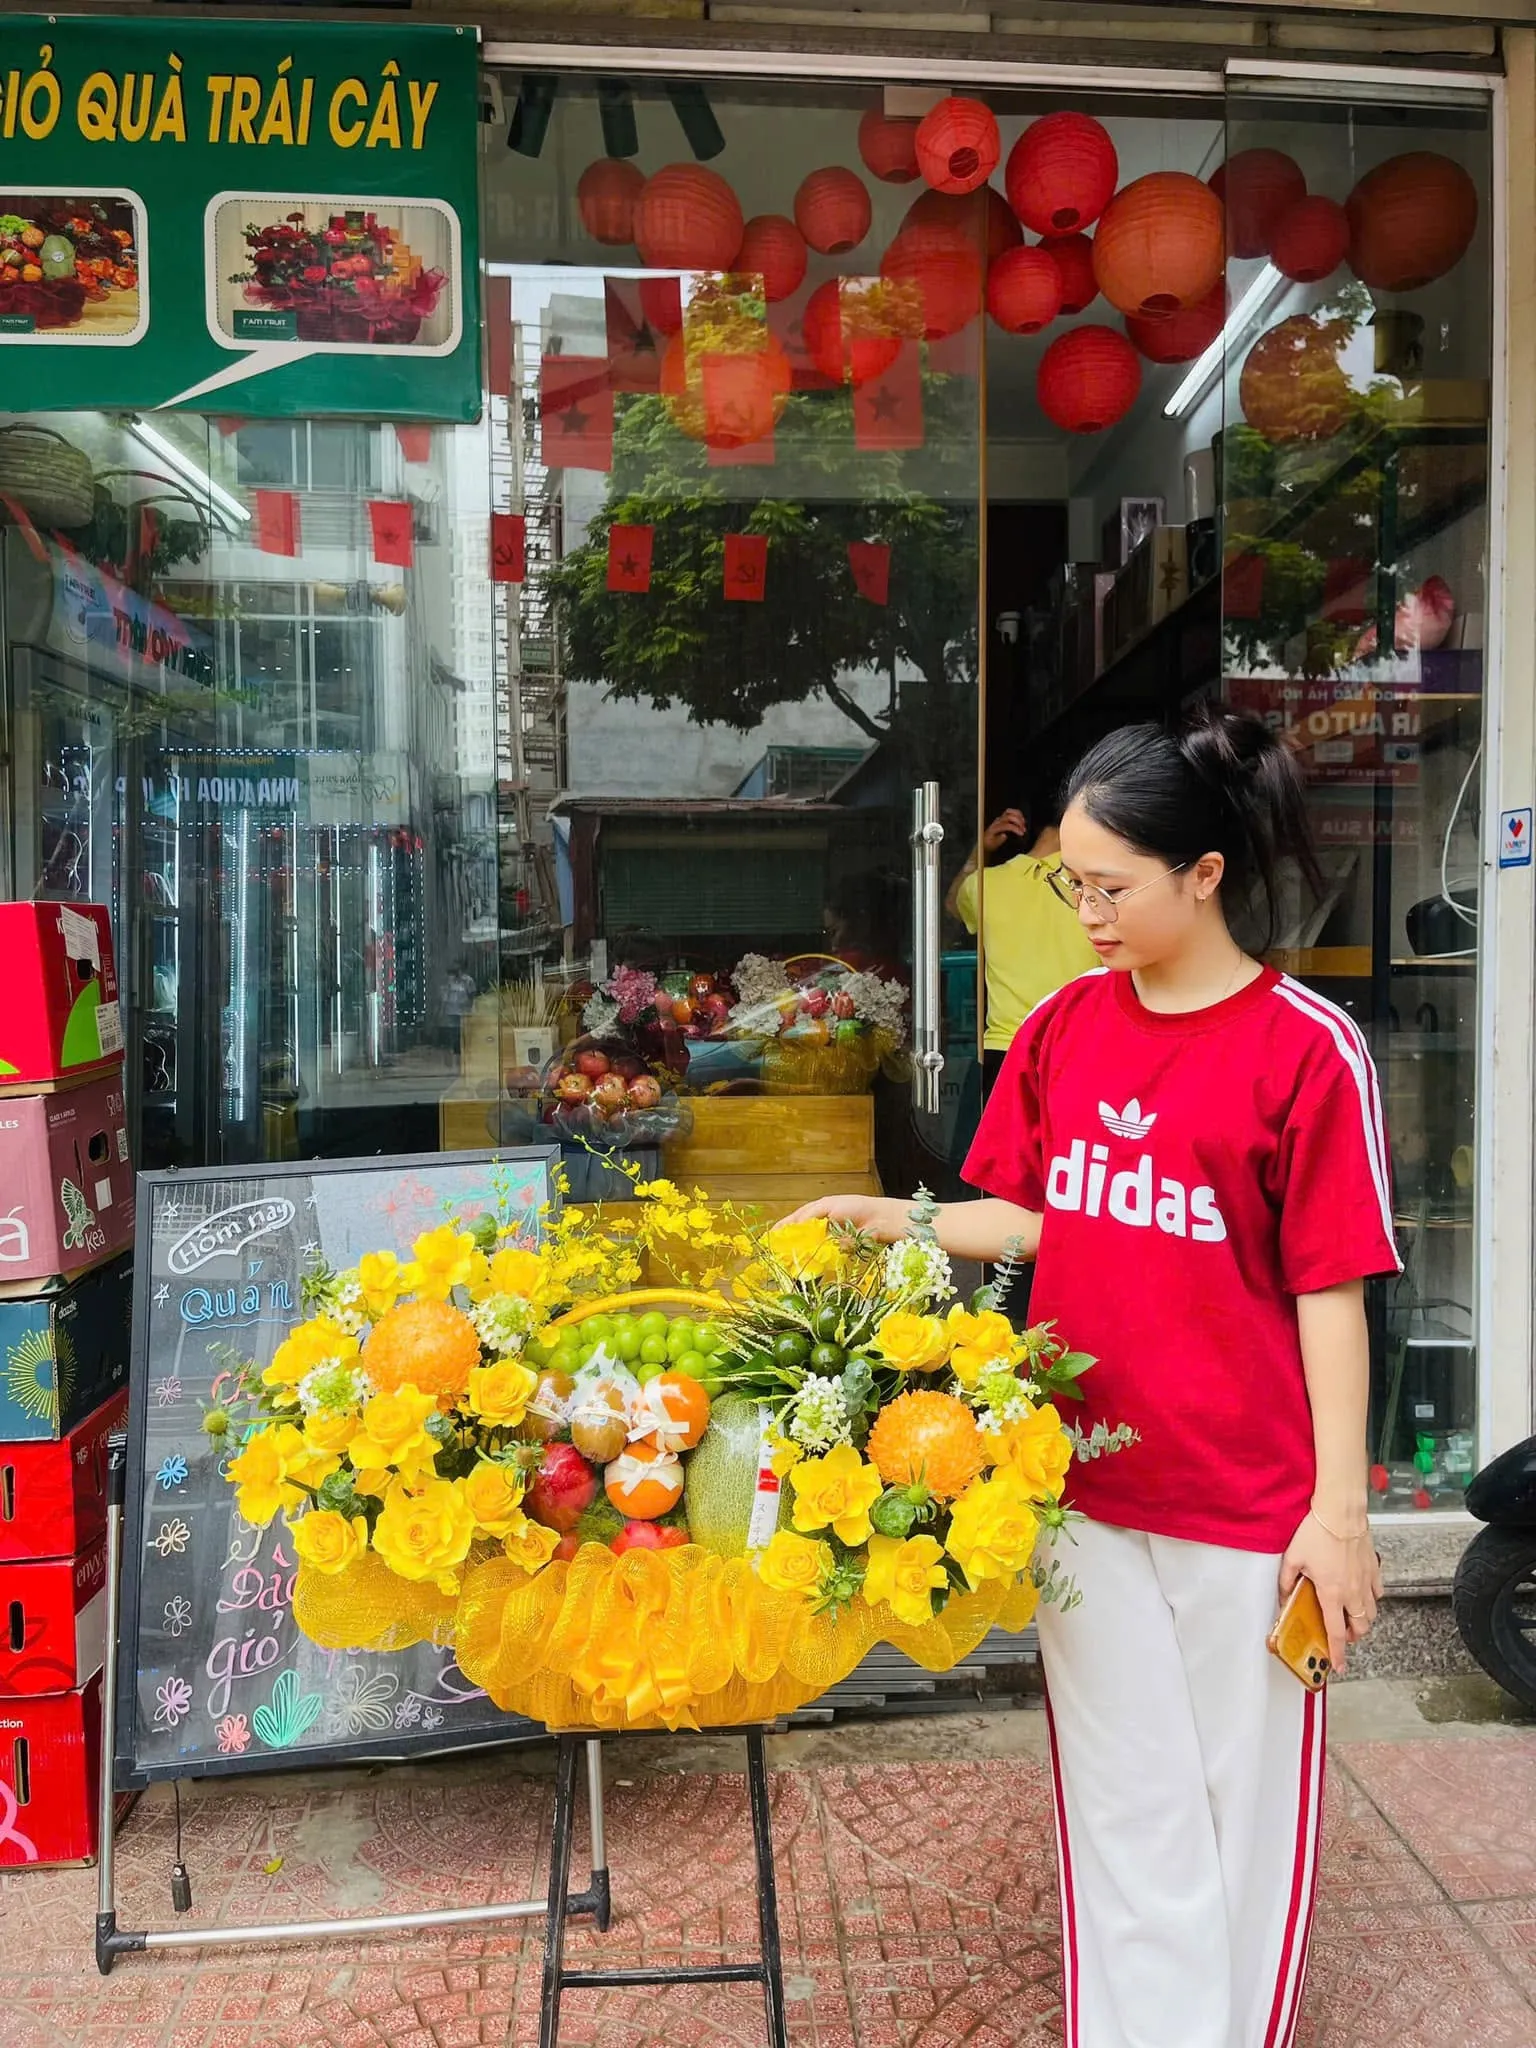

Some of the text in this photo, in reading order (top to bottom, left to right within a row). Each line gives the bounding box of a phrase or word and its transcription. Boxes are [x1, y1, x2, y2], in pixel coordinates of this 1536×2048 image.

[0, 44, 440, 150] IỎ QUÀ TRÁI CÂY
[178, 1203, 288, 1266] Hôm nay
[180, 1259, 293, 1324] Quán
[206, 1609, 281, 1719] giỏ
